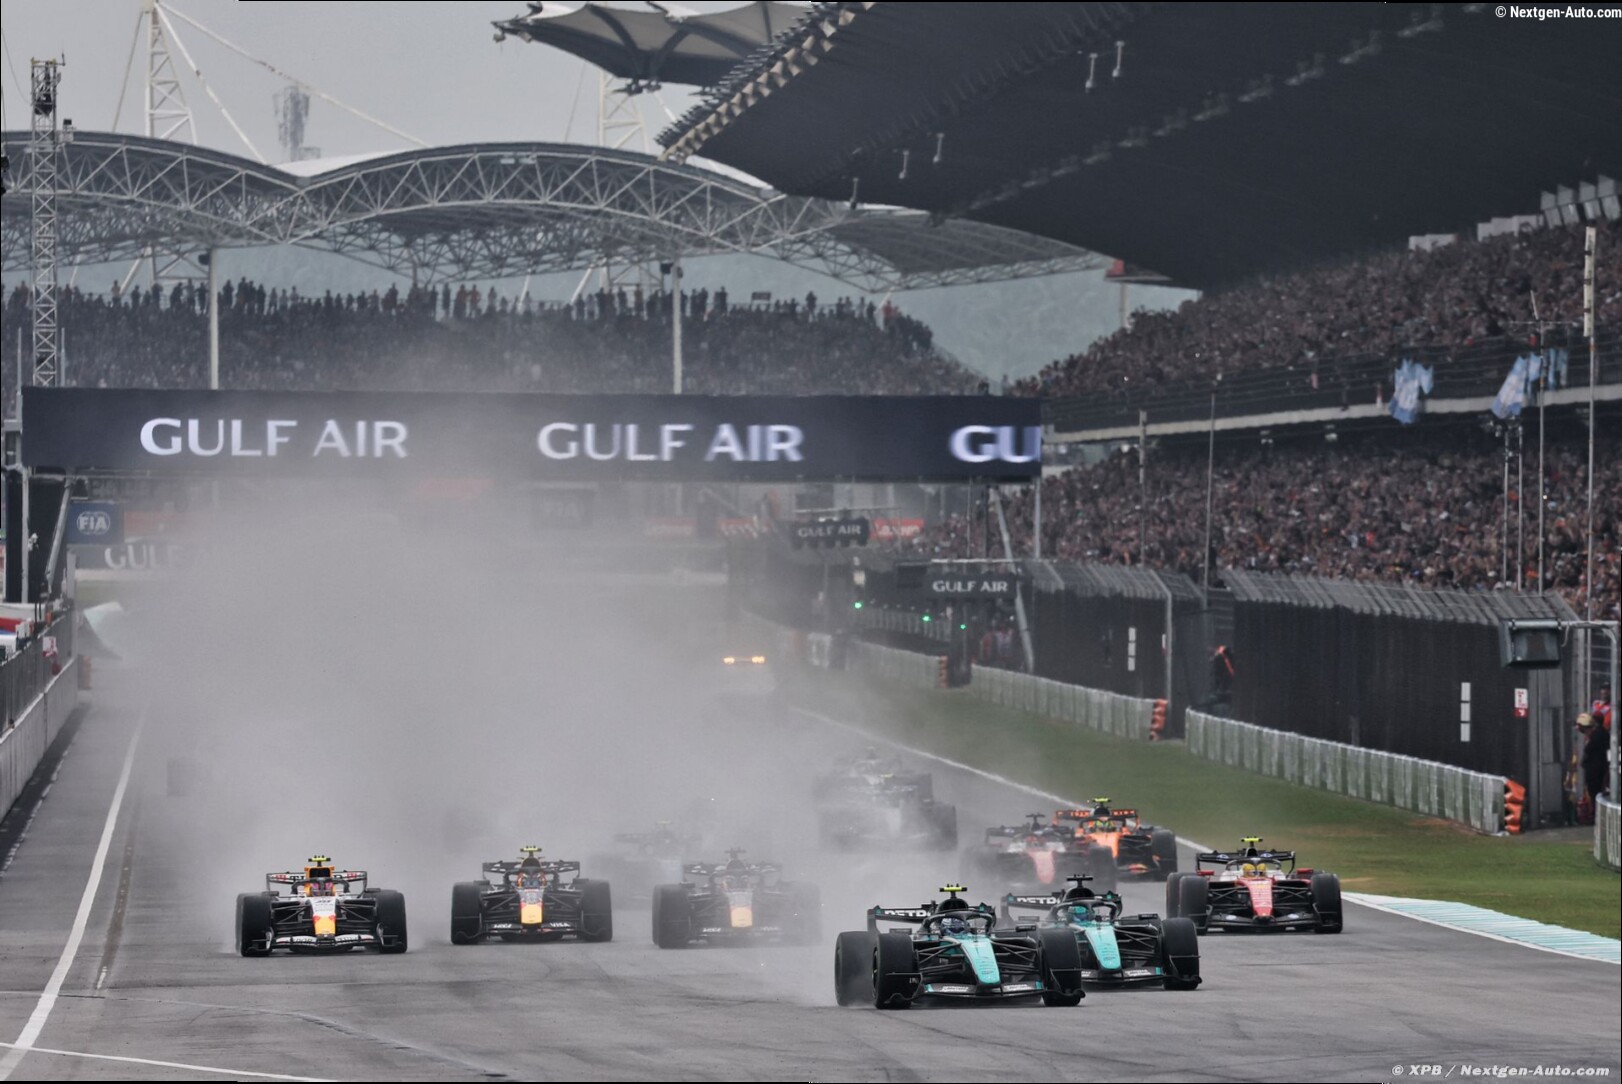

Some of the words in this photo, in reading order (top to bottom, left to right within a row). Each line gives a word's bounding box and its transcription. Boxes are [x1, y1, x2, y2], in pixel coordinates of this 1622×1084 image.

[139, 417, 298, 457] GULF
[312, 420, 410, 458] AIR
[537, 422, 694, 461] GULF
[704, 423, 804, 462] AIR
[77, 514, 110, 532] FIA
[837, 523, 862, 537] AIR
[932, 580, 976, 592] GULF
[980, 580, 1009, 592] AIR
